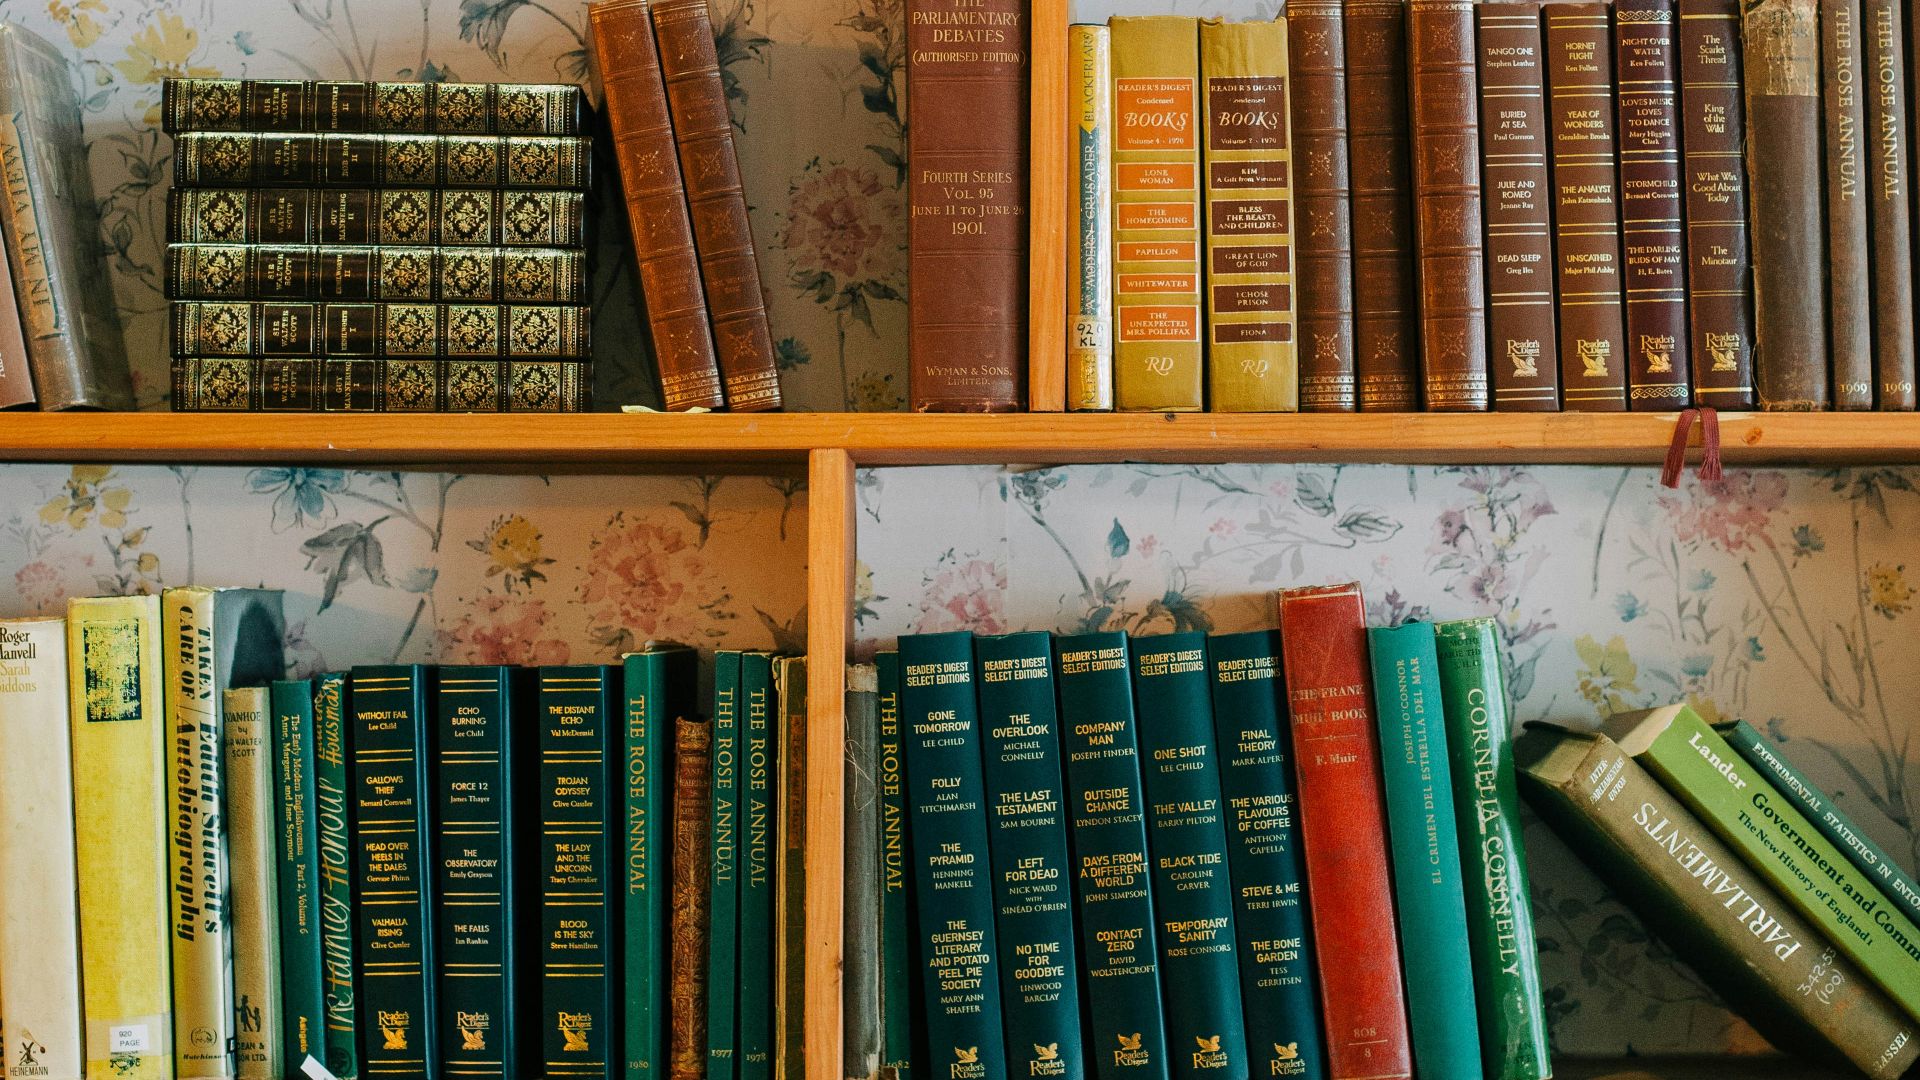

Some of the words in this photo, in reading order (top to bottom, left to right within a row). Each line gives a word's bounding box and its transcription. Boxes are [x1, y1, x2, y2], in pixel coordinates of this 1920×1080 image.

[913, 12, 1020, 25] PARLIAMENTARY
[1836, 7, 1851, 49] THE
[1877, 6, 1893, 48] THE
[933, 29, 1004, 43] DEBATES
[1622, 38, 1648, 46] NIGHT
[1649, 38, 1670, 46] OVER
[1703, 34, 1720, 44] The
[1487, 47, 1515, 56] TANGO
[1516, 47, 1533, 56] ONE
[1565, 42, 1596, 50] HORNET
[913, 50, 978, 66] (AUTHORISED
[983, 51, 1026, 65] EDITION)
[1699, 54, 1726, 64] Thread
[1083, 32, 1094, 121] BLACKFRIARS
[1837, 55, 1853, 107] ROSE
[1879, 55, 1896, 106] ROSE
[1500, 110, 1526, 119] BURIED
[1567, 110, 1586, 119] YEAR
[1588, 110, 1600, 119] OF
[1704, 104, 1724, 114] King
[1124, 112, 1188, 131] BOOKS
[1219, 111, 1279, 130] BOOKS
[1501, 121, 1511, 129] AT
[1513, 121, 1527, 129] SEA
[1564, 120, 1604, 129] WONDERS
[1839, 115, 1855, 200] ANNUAL
[1882, 112, 1899, 200] ANNUAL
[1502, 191, 1531, 199] ROMEO
[1562, 186, 1576, 194] THE
[1577, 185, 1611, 193] ANALYST
[1126, 216, 1187, 224] HOMECOMING
[952, 222, 987, 236] 1901.
[1711, 246, 1727, 256] The
[1497, 254, 1519, 262] DEAD
[1521, 254, 1541, 262] SLEEP
[1567, 254, 1612, 262] UNSCATHED
[1127, 280, 1188, 288] WHITEWATER
[1130, 319, 1188, 328] UNEXPECTED
[926, 366, 967, 377] WYMAN
[981, 365, 1012, 376] SONS.
[1840, 380, 1868, 395] 1969
[1885, 380, 1912, 394] 1969
[0, 627, 30, 646] Roger
[179, 605, 194, 665] CARE
[0, 661, 30, 676] Sarah
[907, 664, 942, 675] READER'S
[944, 662, 968, 672] DIGEST
[1410, 656, 1422, 685] MAR
[181, 669, 195, 700] OF
[907, 675, 935, 686] SELECT
[937, 673, 970, 684] EDITIONS
[1395, 659, 1411, 721] O'CONNOR
[718, 687, 733, 729] THE
[1413, 688, 1424, 715] DEL
[458, 707, 479, 715] ECHO
[549, 706, 563, 714] THE
[564, 706, 595, 714] DISTANT
[750, 687, 765, 730] THE
[452, 717, 486, 725] BURNING
[561, 716, 583, 725] ECHO
[629, 695, 645, 739] THE
[928, 710, 956, 721] GONE
[1009, 714, 1030, 724] THE
[913, 721, 970, 734] TOMORROW
[993, 725, 1048, 738] OVERLOOK
[1075, 721, 1125, 735] COMPANY
[1241, 730, 1271, 741] FINAL
[1405, 718, 1417, 765] JOSEPH
[292, 733, 301, 756] Early
[1004, 741, 1040, 750] MICHAEL
[1238, 741, 1276, 753] THEORY
[1418, 718, 1432, 781] ESTRELLA
[1001, 752, 1044, 762] CONNELLY
[1154, 749, 1177, 760] ONE
[1180, 746, 1206, 758] SHOT
[1467, 688, 1501, 824] CORNELIA
[717, 737, 733, 789] ROSE
[750, 738, 765, 791] ROSE
[1688, 731, 1747, 790] Lander
[293, 758, 303, 793] Modern
[629, 745, 645, 798] ROSE
[452, 783, 476, 791] FORCE
[932, 778, 961, 788] FOLLY
[555, 787, 590, 796] ODYSSEY
[1000, 792, 1022, 803] THE
[1024, 790, 1051, 801] LAST
[1084, 788, 1129, 801] OUTSIDE
[1423, 784, 1433, 809] DEL
[996, 802, 1057, 816] TESTAMENT
[1086, 800, 1129, 812] CHANCE
[1154, 803, 1175, 815] THE
[1177, 800, 1216, 812] VALLEY
[1753, 742, 1825, 812] EXPERIMENTAL
[1824, 812, 1878, 865] STATISTICS
[1877, 863, 1892, 879] IN
[1238, 807, 1289, 820] FLAVOURS
[175, 710, 199, 942] Autobiography
[1238, 821, 1252, 832] OF
[1254, 818, 1290, 830] COFFEE
[716, 797, 733, 885] ANNUAL
[750, 799, 765, 887] ANNUAL
[1425, 813, 1439, 865] CRIMEN
[629, 805, 645, 895] ANNUAL
[1752, 793, 1847, 885] Government
[1843, 882, 1877, 914] and
[445, 859, 497, 868] OBSERVATORY
[930, 854, 974, 866] PYRAMID
[1160, 856, 1195, 868] BLACK
[1197, 853, 1221, 864] TIDE
[1005, 870, 1027, 881] FOR
[1030, 868, 1058, 880] DEAD
[1432, 871, 1442, 884] EL
[1738, 810, 1757, 833] The
[1757, 830, 1779, 854] New
[1779, 851, 1816, 891] History
[1815, 886, 1829, 900] of
[1826, 899, 1869, 941] England
[1633, 802, 1802, 962] PARLIAMENTS
[1486, 836, 1520, 977] CONNELLY
[469, 925, 489, 933] FALLS
[560, 920, 587, 928] BLOOD
[1165, 918, 1228, 933] TEMPORARY
[554, 931, 562, 939] IS
[564, 930, 578, 939] THE
[579, 930, 594, 939] SKY
[931, 931, 984, 943] GUERNSEY
[1097, 928, 1143, 942] CONTACT
[935, 943, 982, 955] LITERARY
[1107, 941, 1134, 952] ZERO
[1251, 940, 1271, 951] THE
[1273, 938, 1300, 949] BONE
[930, 957, 951, 967] AND
[954, 954, 989, 966] POTATO
[1257, 951, 1298, 963] GARDEN
[939, 969, 964, 979] PEEL
[967, 967, 982, 977] PIE
[1015, 966, 1064, 980] GOODBYE
[941, 979, 981, 990] SOCIETY
[1815, 968, 1845, 1004] (100)
[1354, 1027, 1377, 1038] 808
[10, 1066, 49, 1076] HEINEMANN
